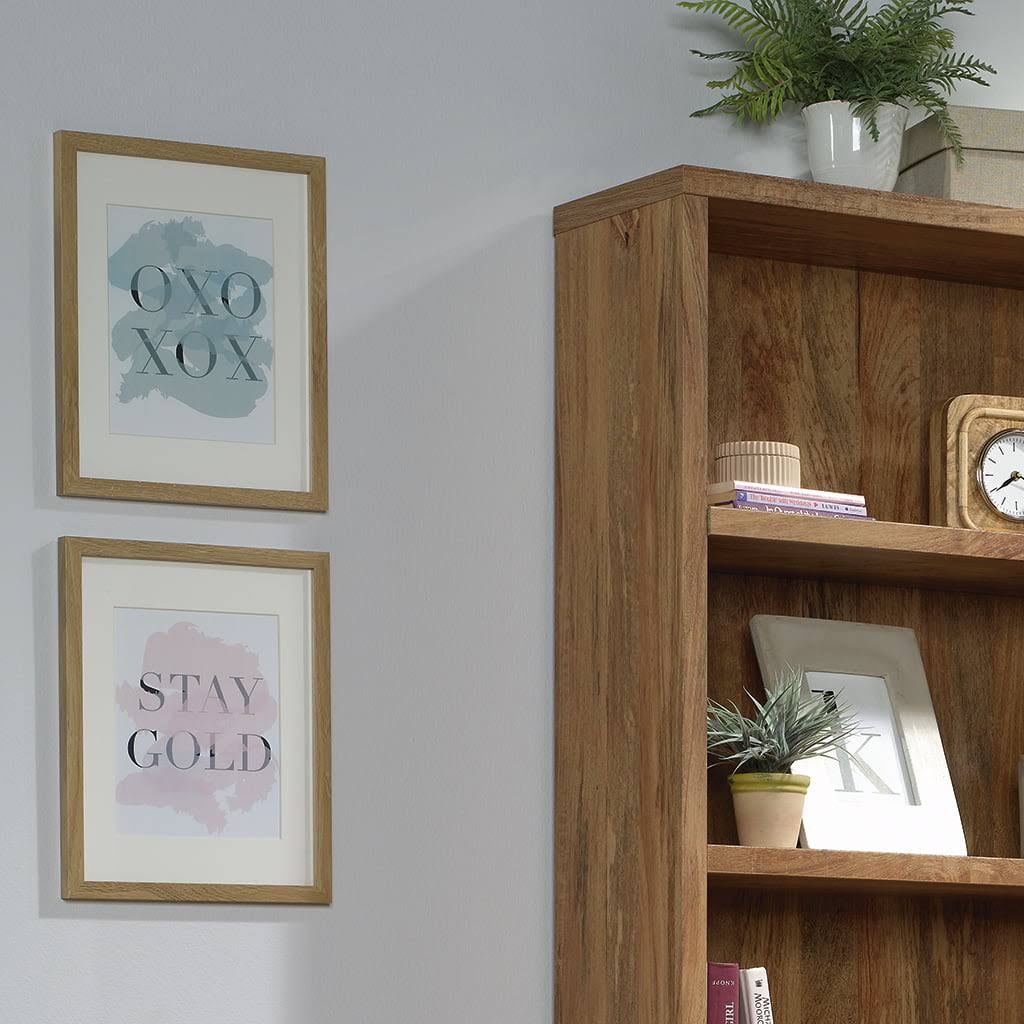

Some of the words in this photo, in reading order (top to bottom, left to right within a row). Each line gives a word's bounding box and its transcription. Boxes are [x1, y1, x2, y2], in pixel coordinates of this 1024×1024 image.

[130, 264, 262, 320] OXO
[131, 327, 263, 382] XOX
[138, 671, 264, 716] STAY
[127, 728, 272, 773] GOLD
